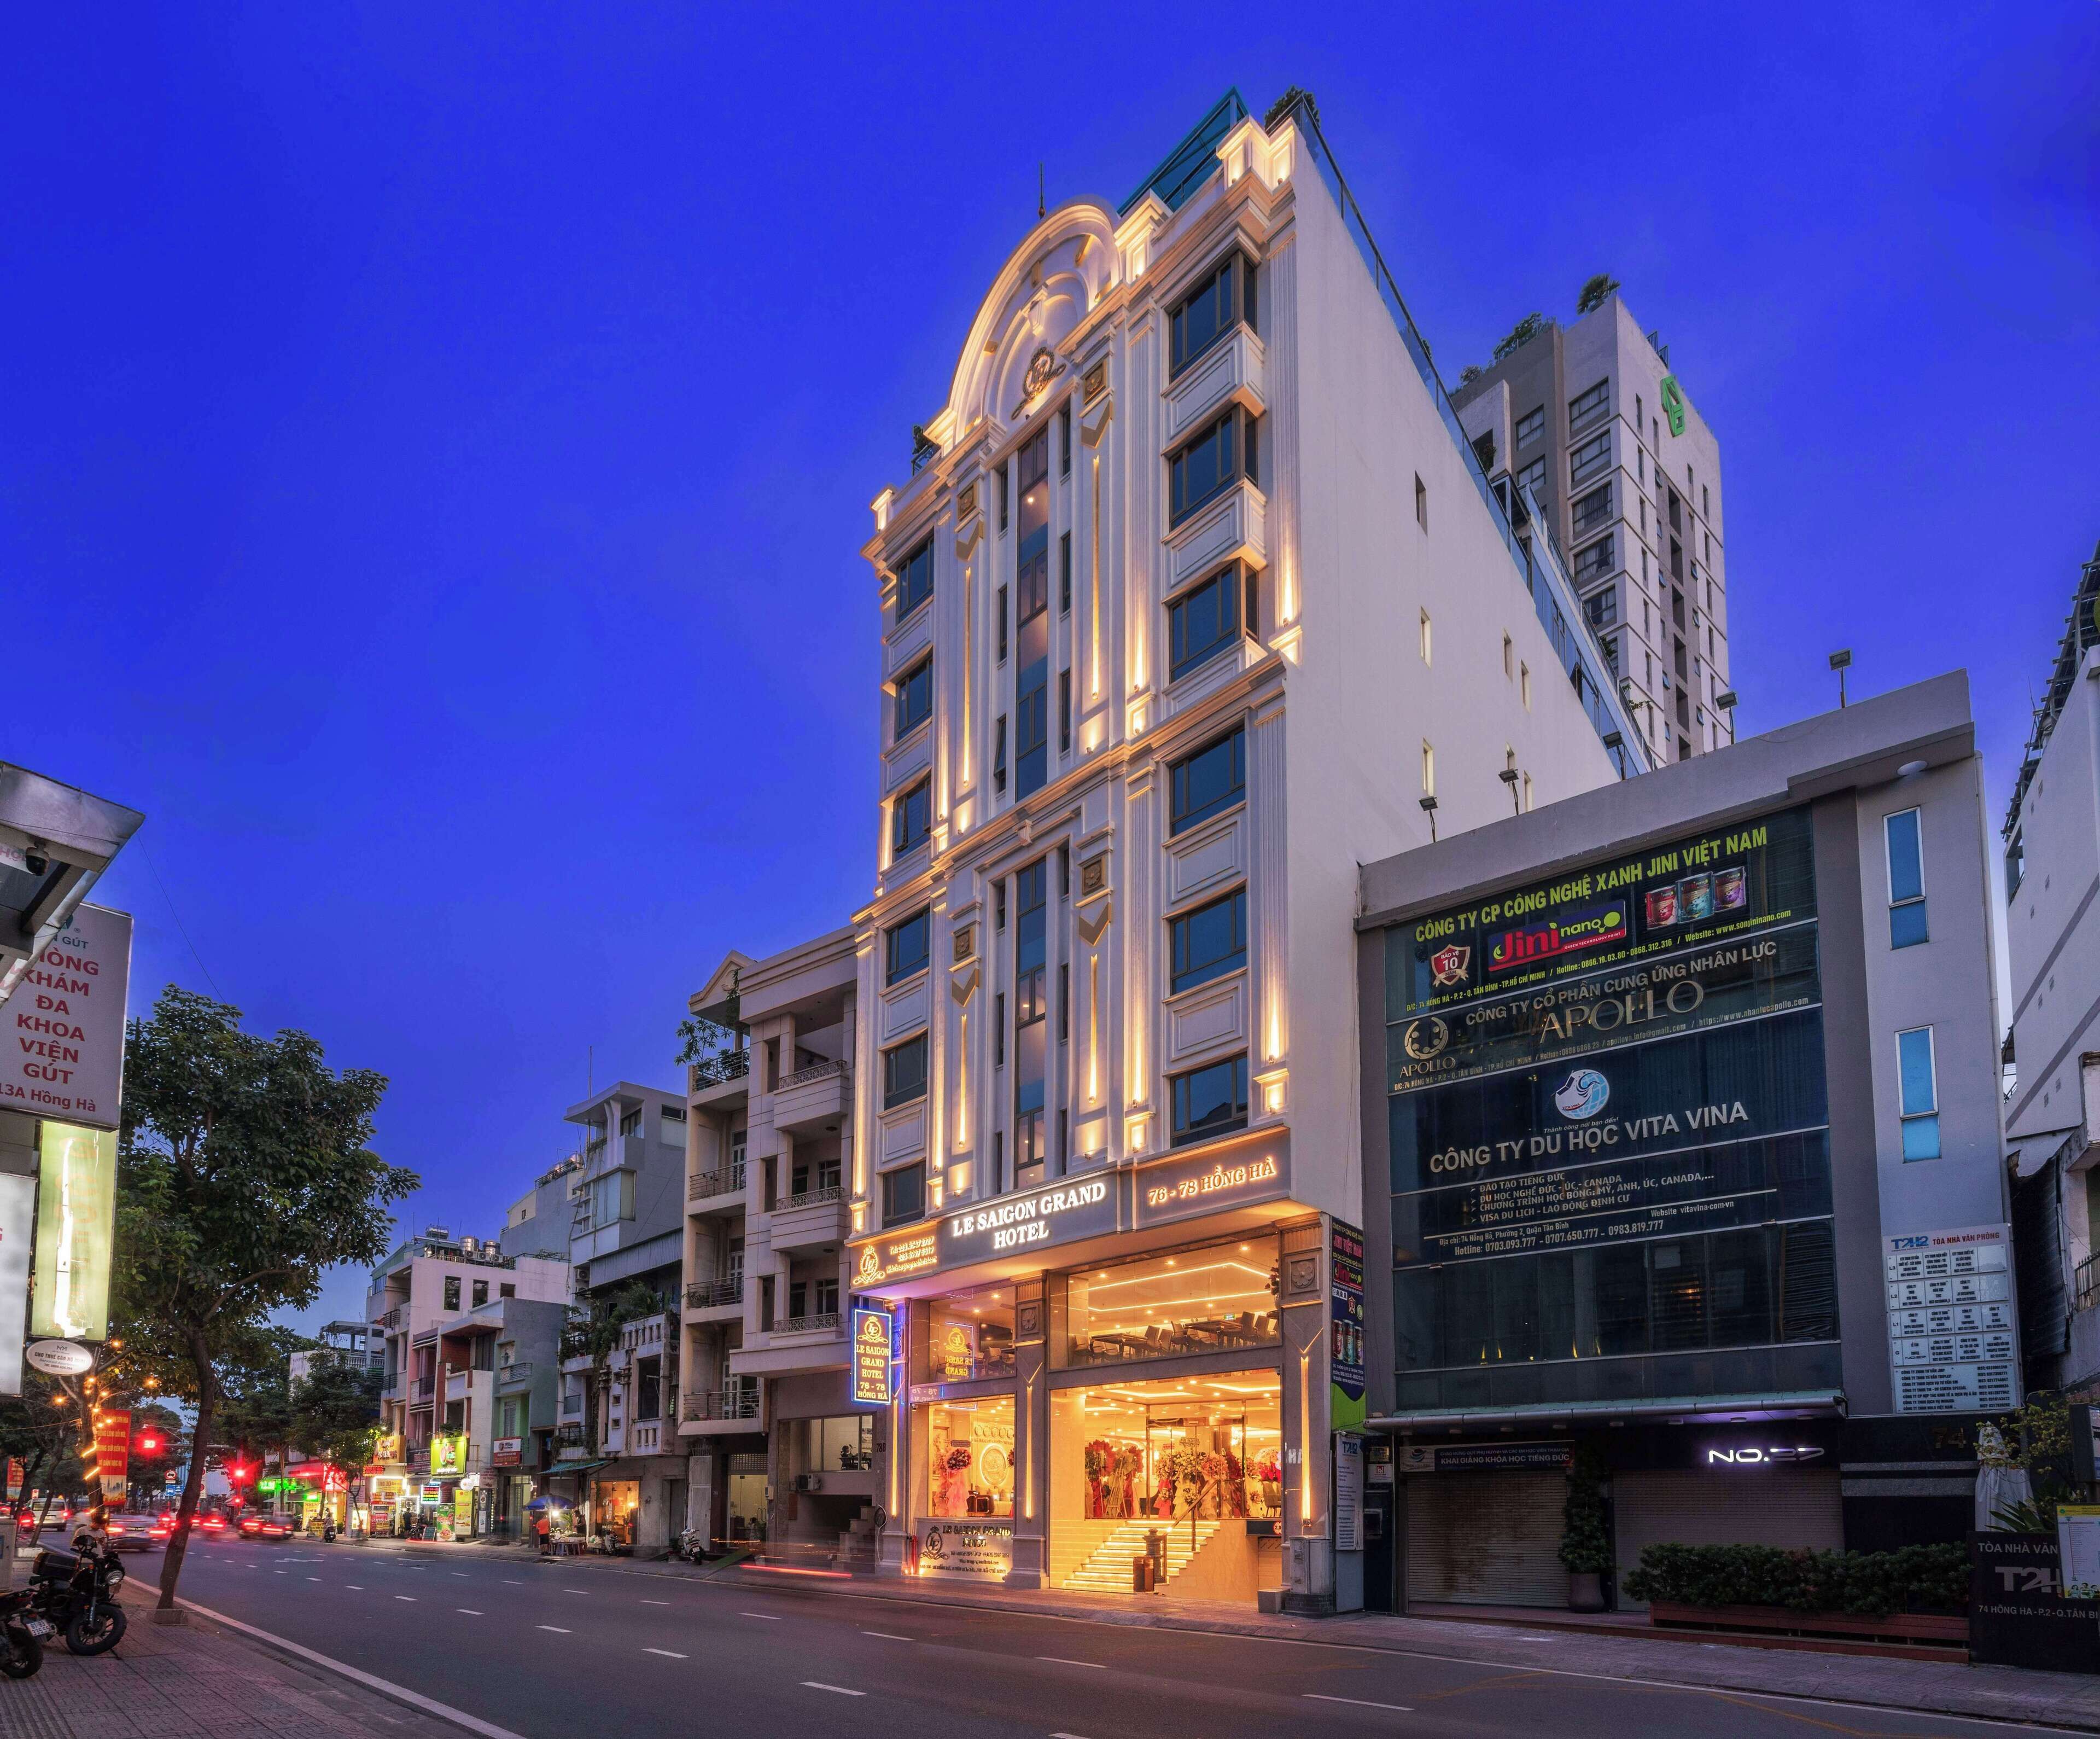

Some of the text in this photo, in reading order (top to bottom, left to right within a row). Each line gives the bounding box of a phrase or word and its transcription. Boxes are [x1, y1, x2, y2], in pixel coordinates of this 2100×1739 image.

[1416, 827, 1767, 941] CÔNG TY CP CÔNG NGHỆ XANH JINI VIỆT NAM
[62, 936, 88, 949] GÚT
[1497, 919, 1602, 963] Jini nano
[1530, 971, 1545, 981] MINH
[1557, 963, 1580, 974] Hotline:
[1685, 929, 1714, 943] Website:
[1716, 909, 1791, 935] www.sonjininano.com
[1579, 935, 1607, 947] TECHNOLOGY
[1443, 957, 1458, 971] 10
[1466, 941, 1777, 1025] CÔNG TY CỔ PHẦN CUNG ỨNG NHÂN LỰC
[36, 994, 70, 1015] ĐA
[1540, 980, 1704, 1044] APOLLO
[17, 1014, 85, 1042] KHOA
[19, 1037, 79, 1064] VIỆN
[1518, 1055, 1532, 1065] MINH
[24, 1061, 74, 1084] GÚT
[1400, 1056, 1455, 1078] APOLLO
[31, 1088, 96, 1112] Hồng Hà
[1430, 1101, 1748, 1173] CÔNG TY DU HỌC VITA VINA
[1544, 1125, 1562, 1133] Thành
[1149, 1156, 1275, 1203] 76 78 HỒNG HÀ
[1480, 1195, 1491, 1203] DU
[1494, 1191, 1511, 1202] HỌC
[1538, 1184, 1556, 1194] ĐỨC
[1565, 1180, 1574, 1190] ÚC
[1584, 1174, 1622, 1188] CANADA
[1500, 1180, 1516, 1190] TẠO
[1519, 1175, 1545, 1187] TIẾNG
[1547, 1172, 1565, 1182] ĐỨC
[1479, 1201, 1514, 1212] CHƯƠNG
[1516, 1196, 1544, 1208] TRÌNH
[1547, 1191, 1565, 1203] HỌC
[1617, 1182, 1640, 1191] ANH,
[1643, 1178, 1659, 1188] ÚC,
[953, 1182, 1105, 1236] LE SAIGON GRAND
[1480, 1194, 1630, 1223] VISA DU LỊCH LAO ĐỘNG ĐỊNH CƯ
[1650, 1208, 1677, 1218] Website
[994, 1220, 1049, 1249] HOTEL
[1439, 1238, 1449, 1246] Địa
[1469, 1233, 1484, 1242] Hồng
[1495, 1229, 1518, 1238] Phường
[1526, 1225, 1542, 1235] Quận
[1555, 1222, 1569, 1230] Bình
[1455, 1220, 1664, 1255] Hotline: 0703.093.777 0707.650.777 0983.819.777
[1933, 1237, 1945, 1245] TÒA
[1947, 1236, 1961, 1244] NHÀ
[1976, 1232, 1999, 1241] PHÒNG
[856, 1345, 889, 1357] LE SAIGON
[861, 1357, 884, 1366] GRAND
[861, 1369, 884, 1379] HOTEL
[858, 1389, 888, 1400] HỒNG HÀ
[877, 1443, 886, 1453] 78B
[1509, 1455, 1526, 1463] HỌC
[1978, 1540, 2058, 1555] TÒA NHÀ VĂN
